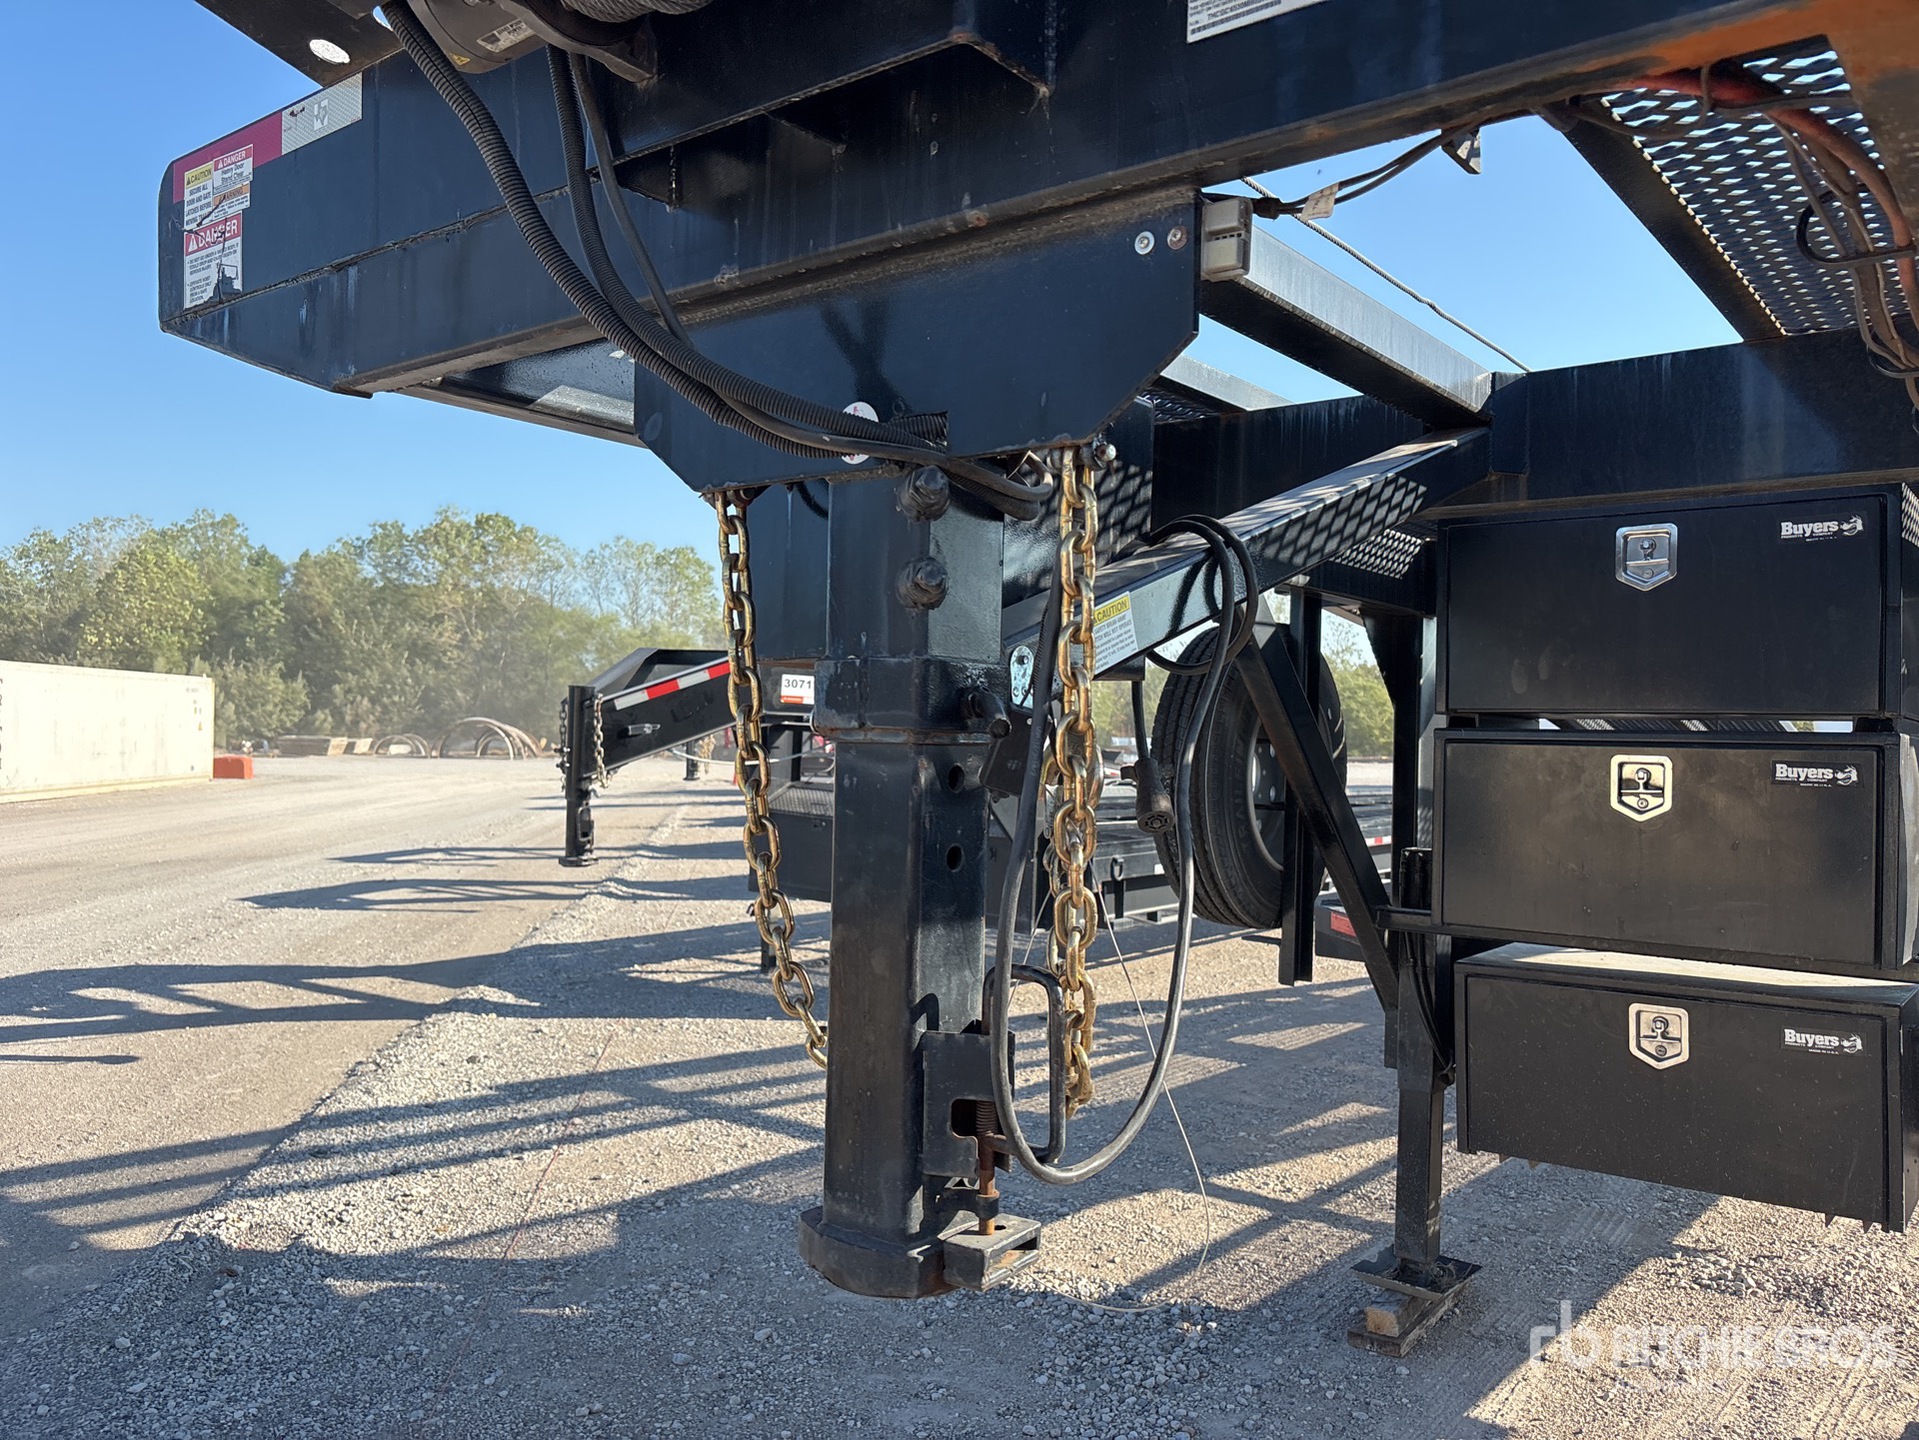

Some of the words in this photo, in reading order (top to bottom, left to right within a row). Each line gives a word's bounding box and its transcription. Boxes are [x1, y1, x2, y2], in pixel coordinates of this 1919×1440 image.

[224, 151, 246, 166] DANGER
[191, 168, 212, 184] CAUTION
[1781, 522, 1839, 537] Buyers
[1096, 600, 1127, 621] CAUTION
[784, 679, 811, 689] 3071
[1776, 764, 1833, 781] Buyers
[1784, 1029, 1839, 1047] Buyers
